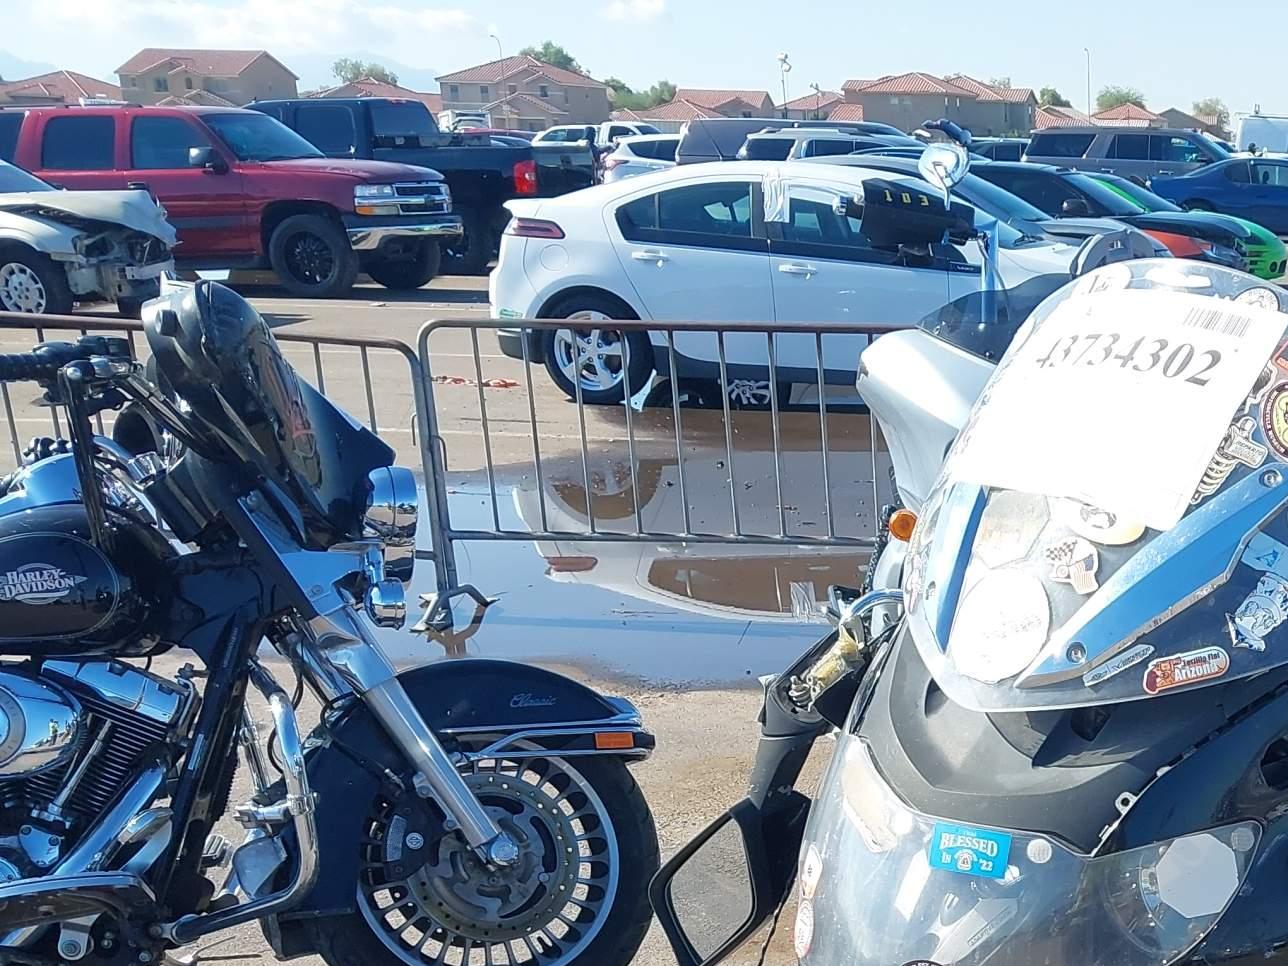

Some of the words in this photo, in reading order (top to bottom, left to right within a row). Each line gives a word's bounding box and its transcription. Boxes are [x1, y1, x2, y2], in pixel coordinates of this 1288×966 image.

[1036, 332, 1222, 387] 43734302
[4, 577, 75, 598] DAVIDSON
[1174, 661, 1218, 681] Arizona
[940, 832, 999, 857] BLESSED
